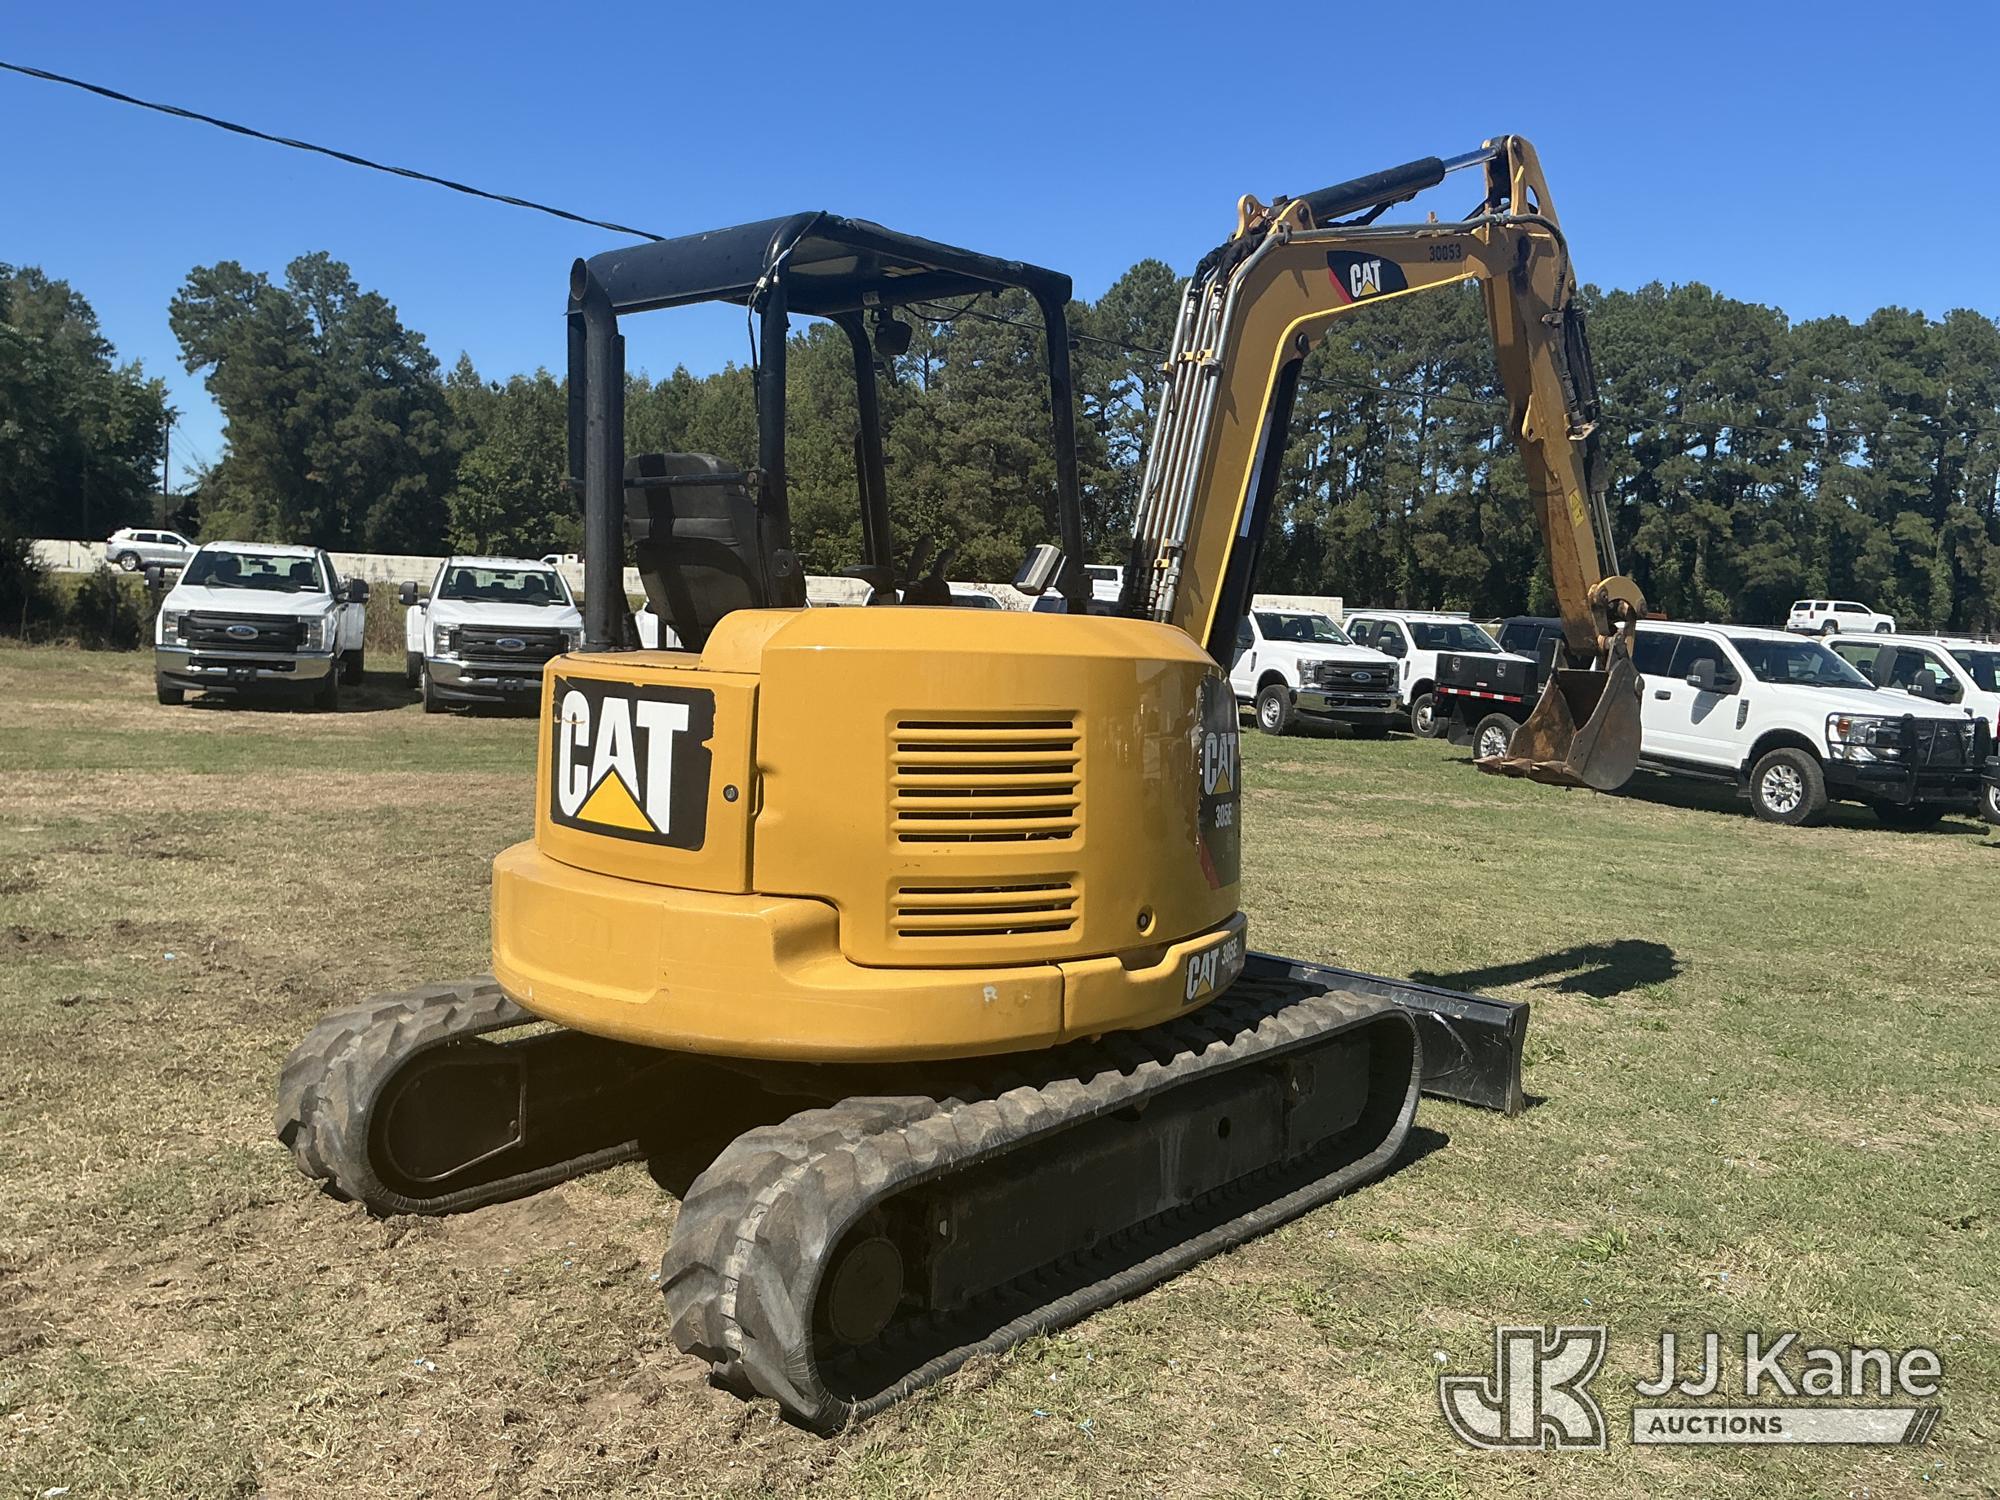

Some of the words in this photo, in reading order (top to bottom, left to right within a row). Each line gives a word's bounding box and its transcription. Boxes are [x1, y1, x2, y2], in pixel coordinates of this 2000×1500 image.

[1350, 260, 1381, 297] CAT
[1429, 243, 1462, 262] 30053
[558, 690, 690, 834] CAT
[1204, 732, 1236, 796] CAT
[1186, 948, 1220, 1000] CAT
